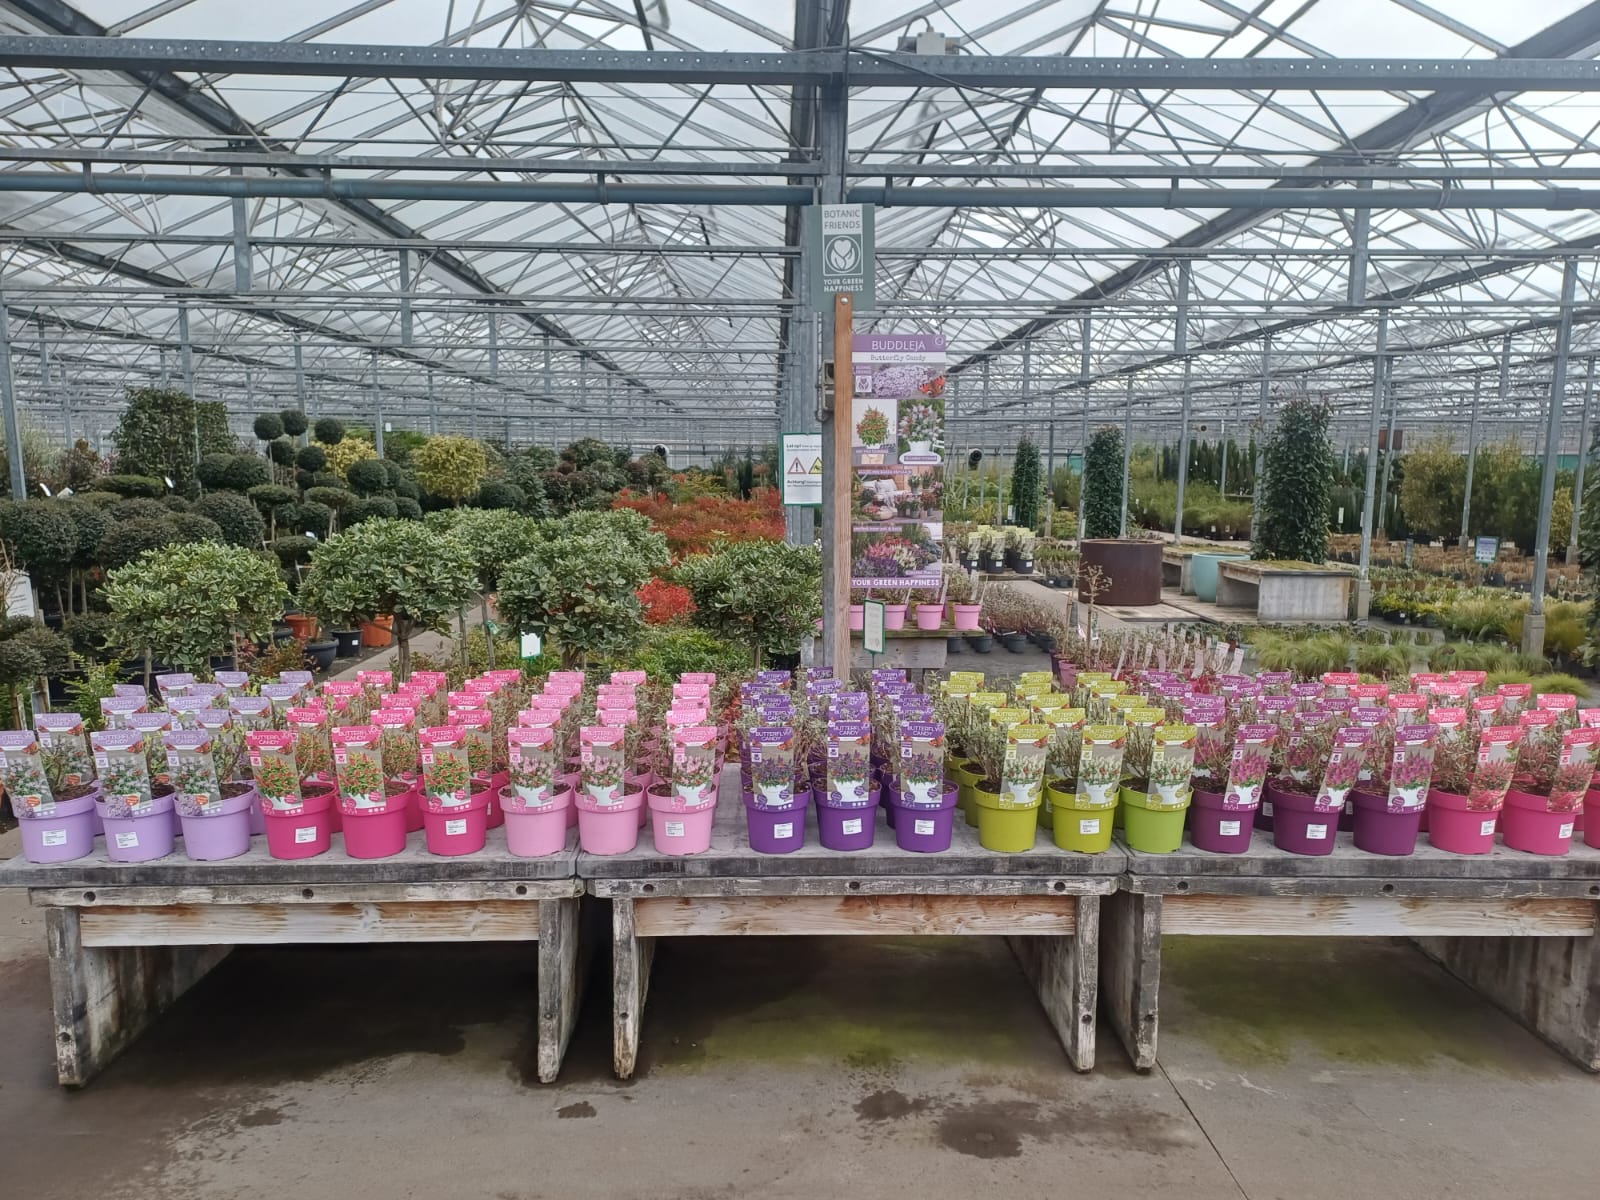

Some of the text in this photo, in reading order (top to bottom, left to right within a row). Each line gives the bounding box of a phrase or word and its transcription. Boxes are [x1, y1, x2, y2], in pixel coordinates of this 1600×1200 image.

[824, 210, 861, 218] BOTANIC
[824, 221, 861, 229] FRIENDS
[872, 340, 926, 351] BUDDLEJA
